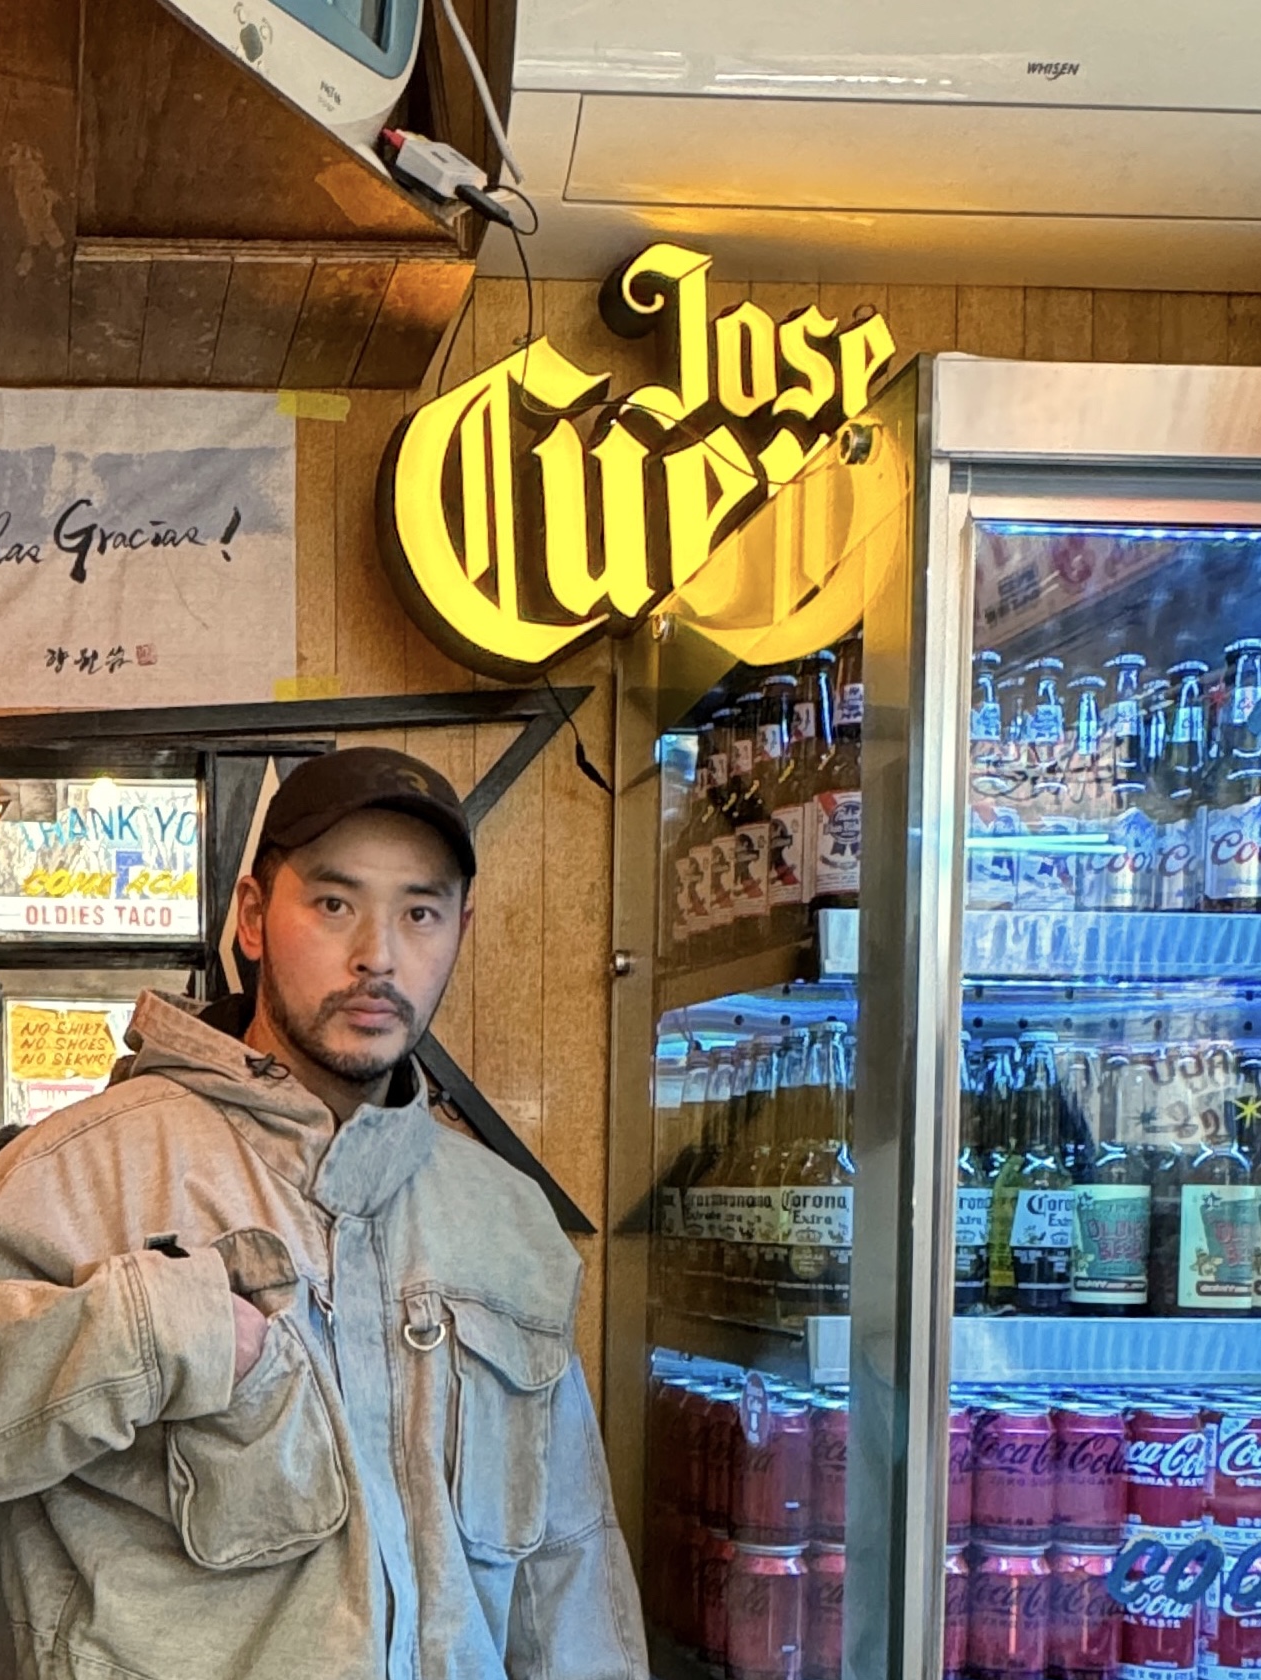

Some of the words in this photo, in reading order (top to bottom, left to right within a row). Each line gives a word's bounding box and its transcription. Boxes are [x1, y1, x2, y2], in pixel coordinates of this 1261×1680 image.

[1026, 62, 1080, 81] WHISEN
[620, 243, 897, 430] Jose
[25, 904, 106, 926] OLDIES
[113, 905, 172, 927] TACO
[20, 1037, 46, 1050] NO
[55, 1036, 108, 1051] SHOES
[20, 1053, 46, 1065] NO
[781, 1190, 850, 1212] Corona
[792, 1209, 833, 1225] Extra
